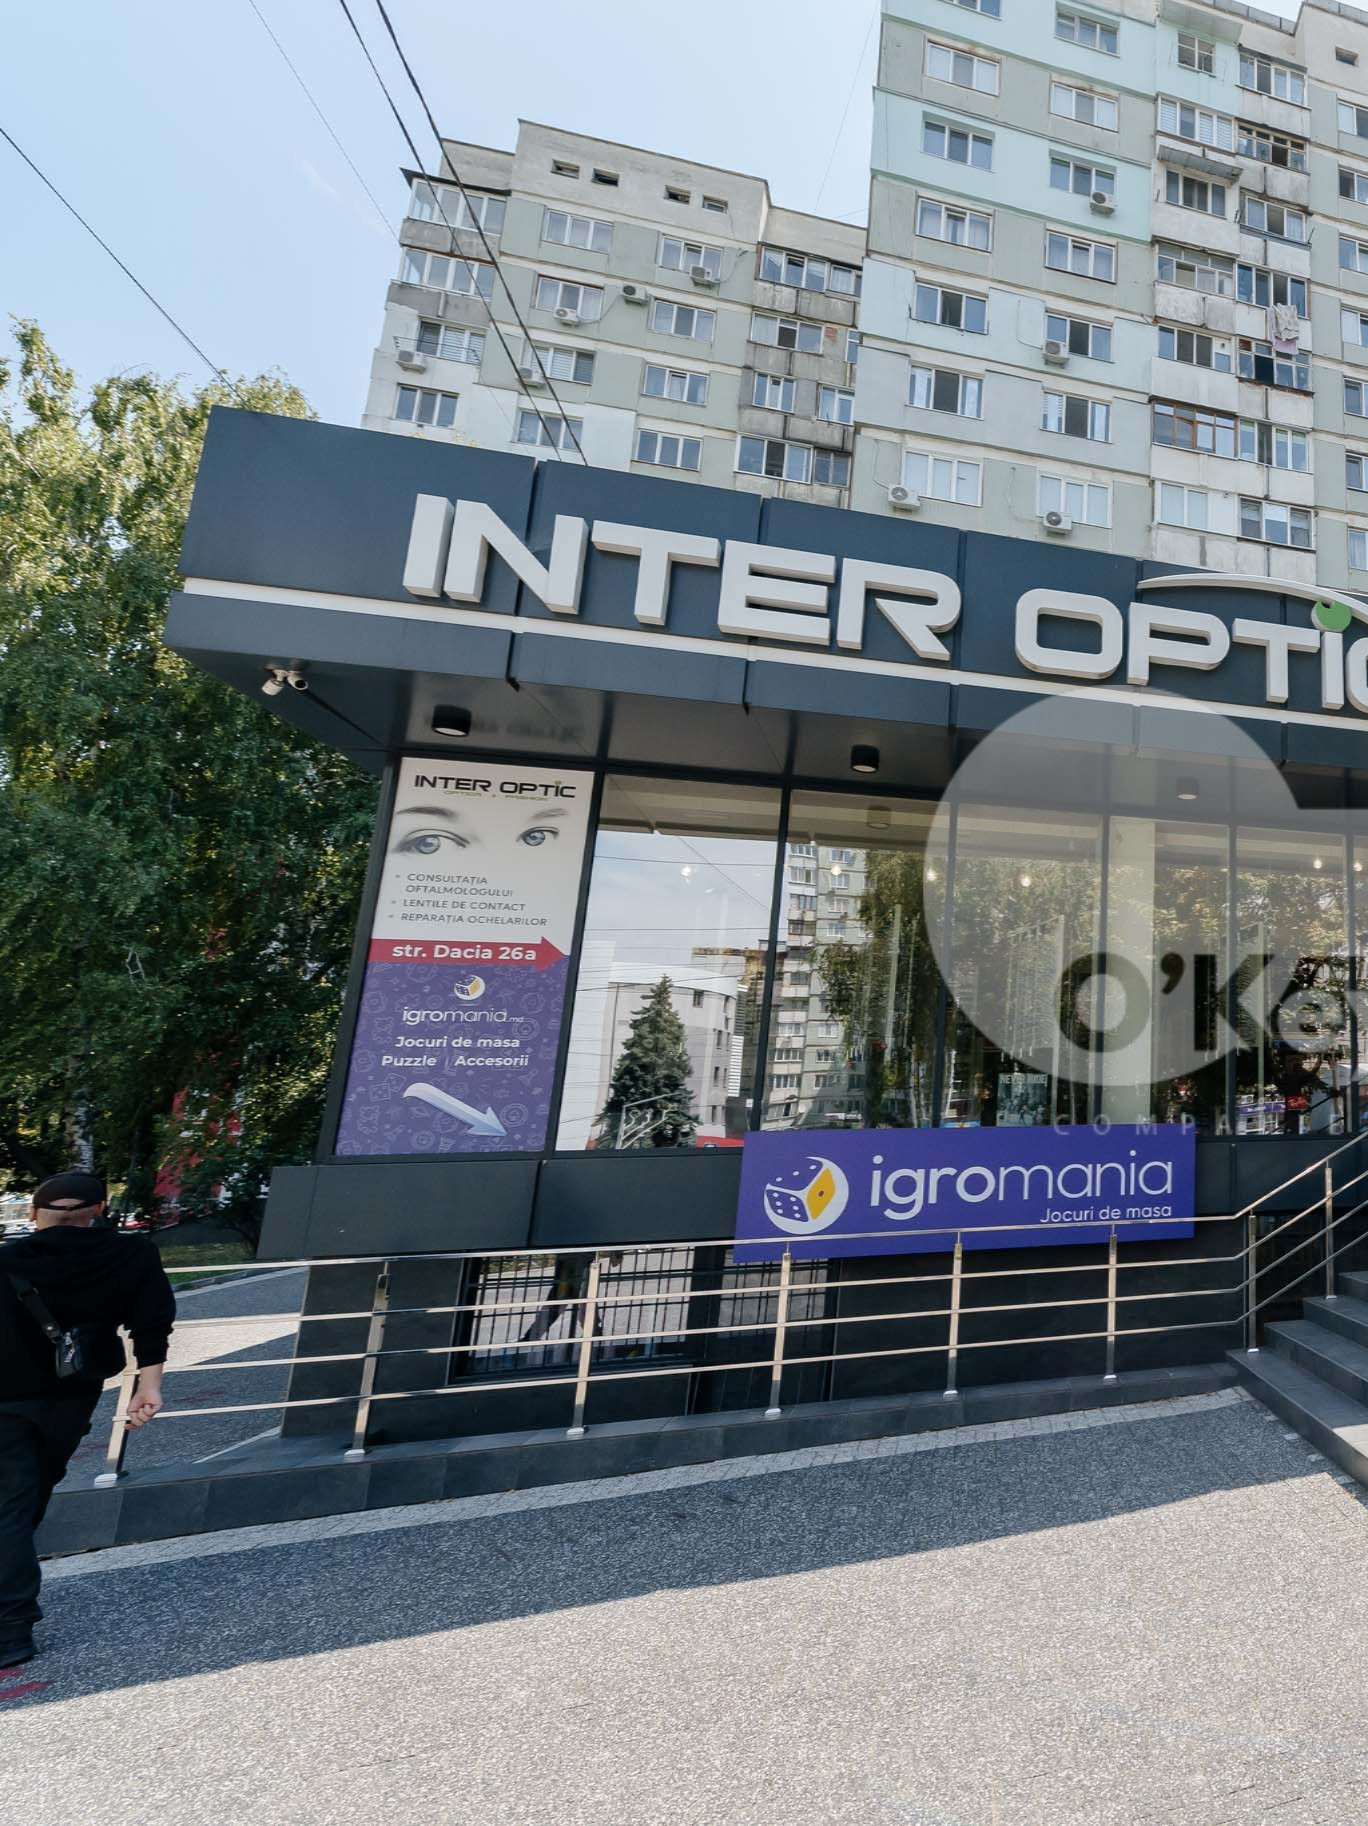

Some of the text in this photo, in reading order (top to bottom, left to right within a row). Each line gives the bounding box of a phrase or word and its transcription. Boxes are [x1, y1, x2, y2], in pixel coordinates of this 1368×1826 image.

[402, 493, 962, 661] INTER
[414, 775, 577, 798] INTER OPTIC
[405, 885, 513, 897] OFTALMOLOGULUI
[402, 899, 526, 912] LENTILE DE CONTACT
[467, 915, 547, 926] OCHELARILOR
[392, 944, 537, 961] str. Dacia 26a
[395, 1036, 520, 1048] Jocuri de masa
[381, 1055, 529, 1067] Puzzle Accesorii
[870, 1149, 1173, 1221] igromania
[1040, 1205, 1172, 1223] Jocuri de masa
